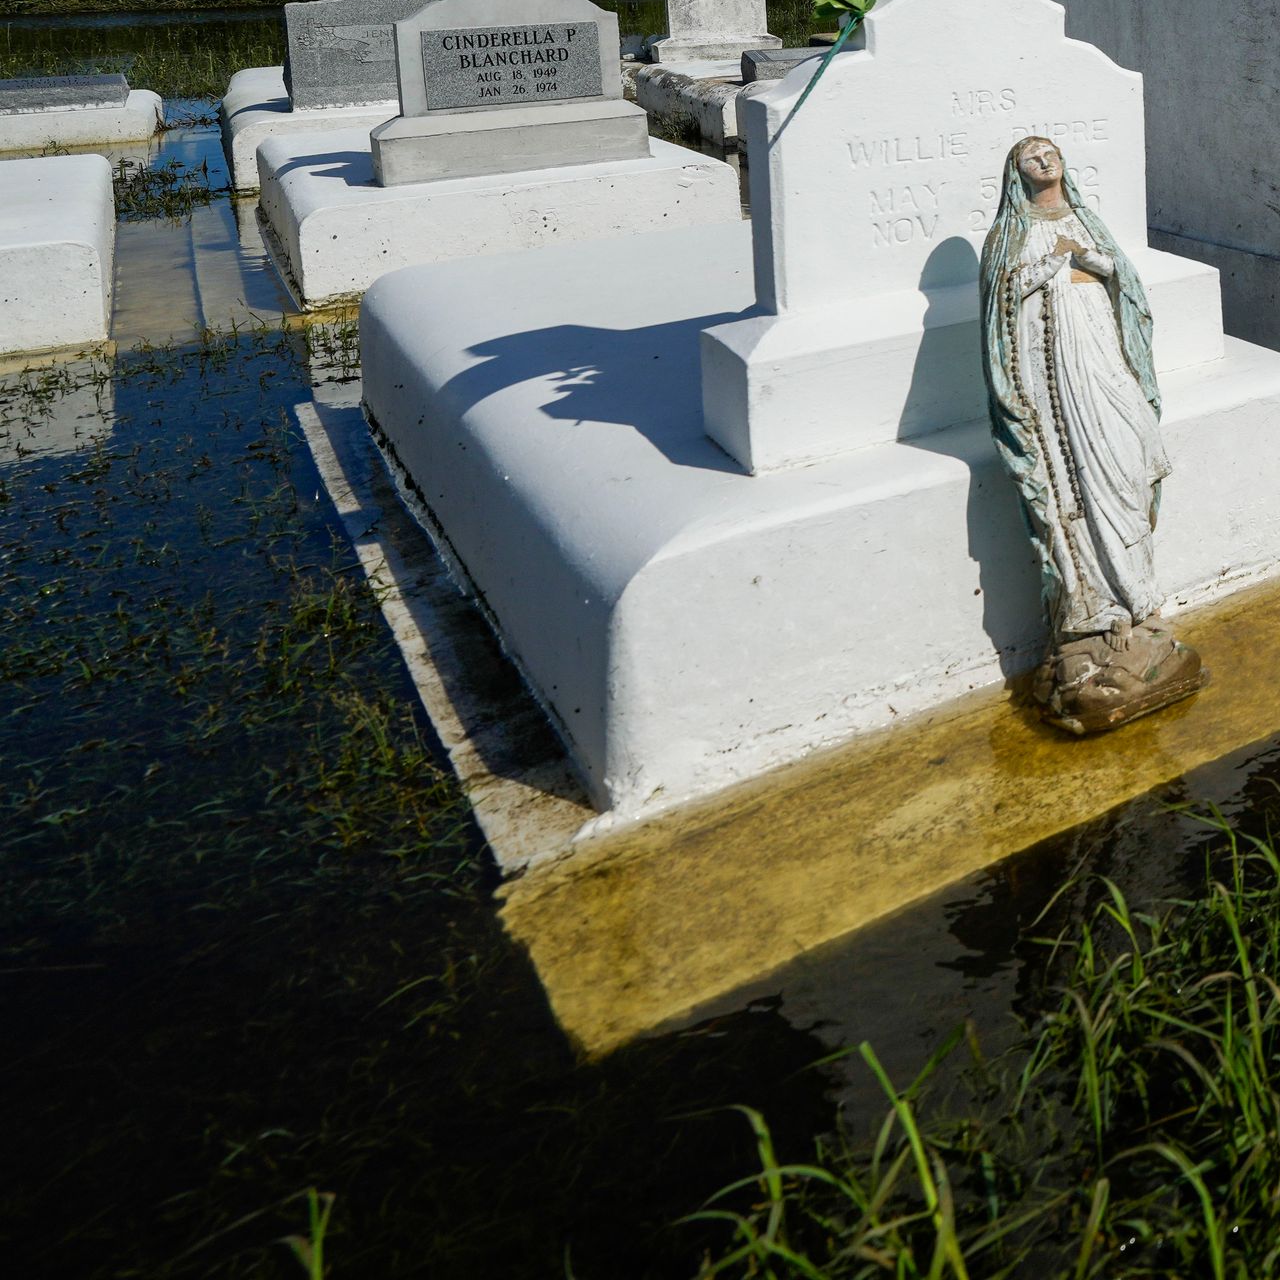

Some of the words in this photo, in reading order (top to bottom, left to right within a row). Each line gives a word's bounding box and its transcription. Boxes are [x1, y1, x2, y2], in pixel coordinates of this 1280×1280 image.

[442, 30, 555, 51] CINDERELLA
[566, 28, 581, 42] P.
[459, 48, 569, 69] BLANCHARD
[476, 71, 502, 83] AUG
[533, 67, 557, 78] 1949
[478, 86, 501, 98] JAN
[536, 82, 558, 93] 1974
[951, 88, 1016, 117] MRS
[846, 132, 969, 169] WILLIE
[870, 180, 952, 216] MAY
[873, 213, 939, 248] NOV
